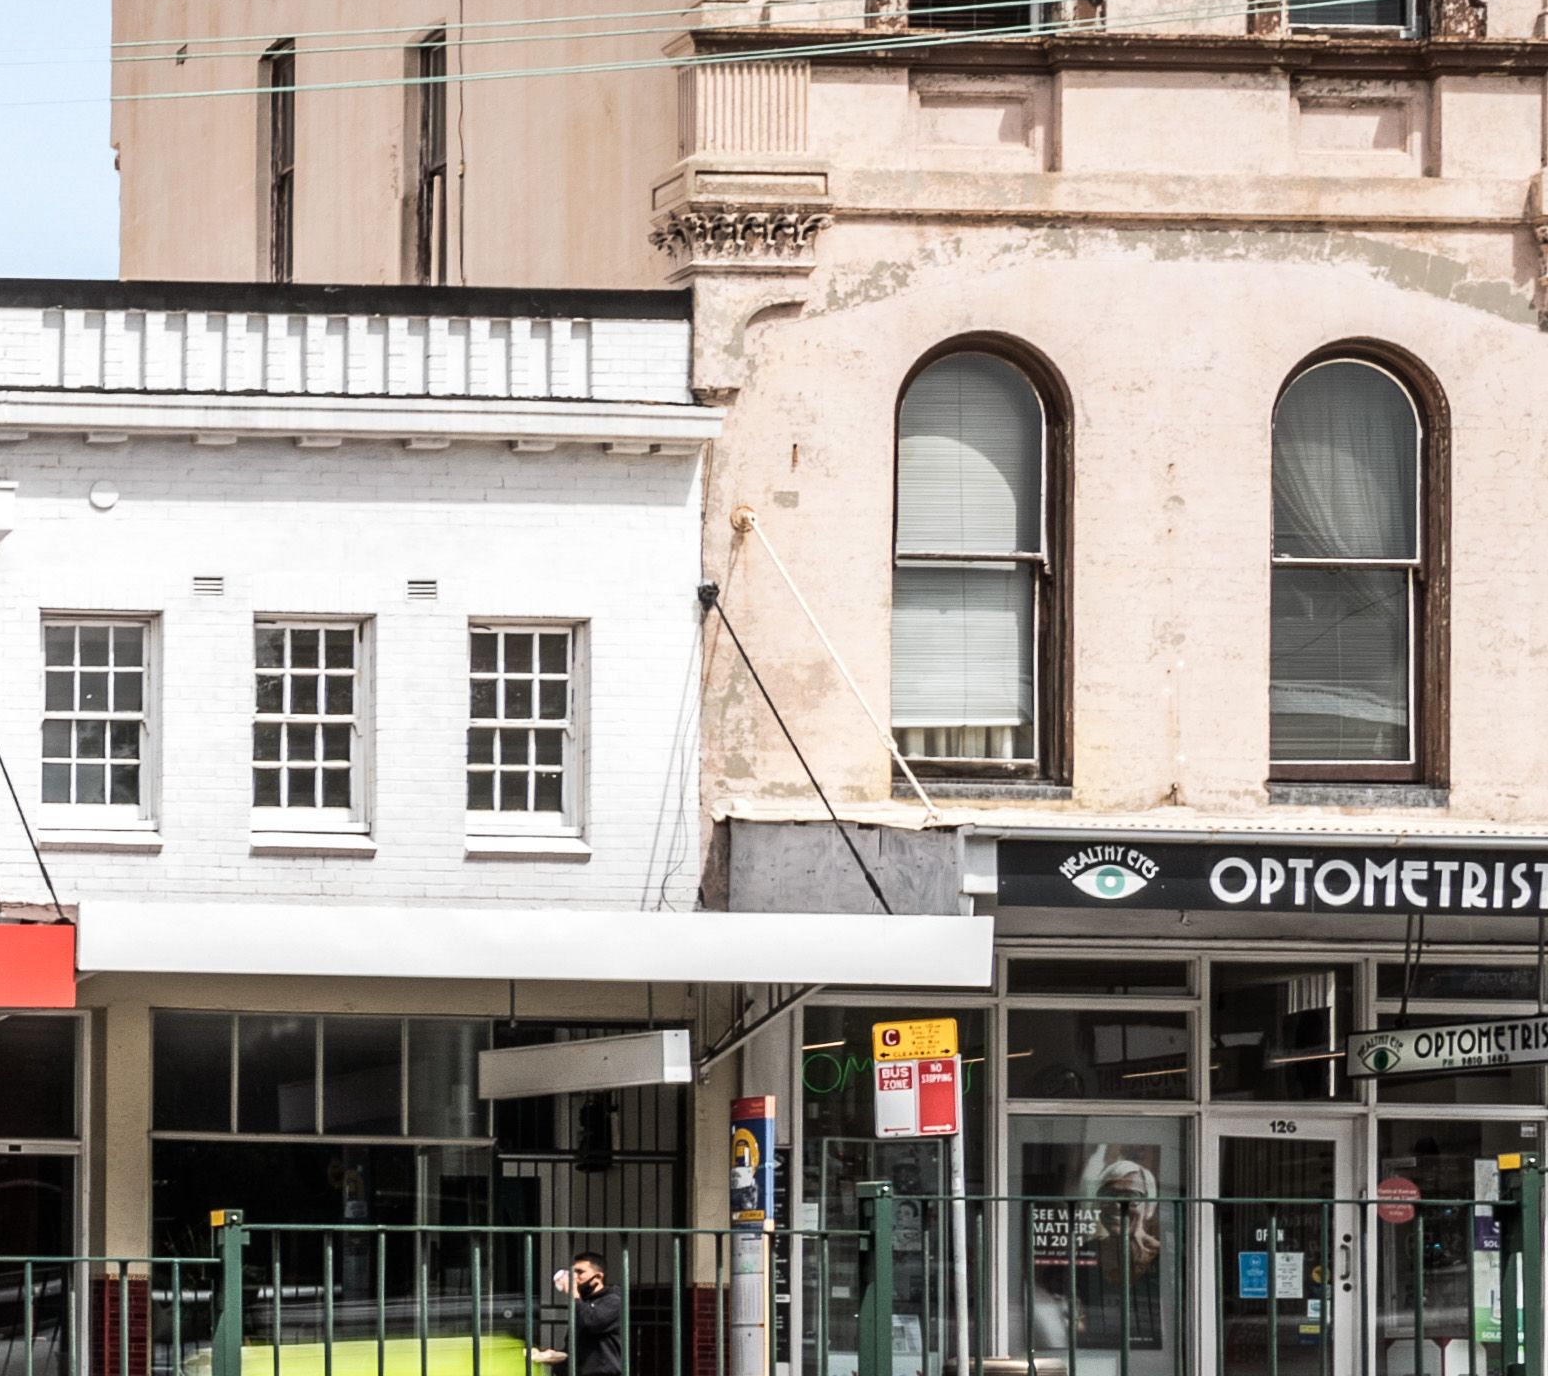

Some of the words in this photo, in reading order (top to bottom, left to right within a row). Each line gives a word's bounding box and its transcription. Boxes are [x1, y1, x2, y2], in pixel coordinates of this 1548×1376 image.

[1059, 845, 1126, 880] HEALTHY
[1127, 849, 1160, 879] EYES
[1209, 857, 1548, 910] OPTOMETRIST
[885, 1029, 897, 1045] C
[881, 1067, 909, 1078] BUS
[930, 1063, 942, 1073] NO
[883, 1079, 909, 1090] ZONE
[921, 1074, 953, 1083] STOPPING
[1269, 1120, 1297, 1134] 126
[1033, 1209, 1054, 1221] SEE
[1058, 1209, 1102, 1221] WHAT
[1050, 1235, 1084, 1247] 201
[1256, 1228, 1284, 1242] OPN
